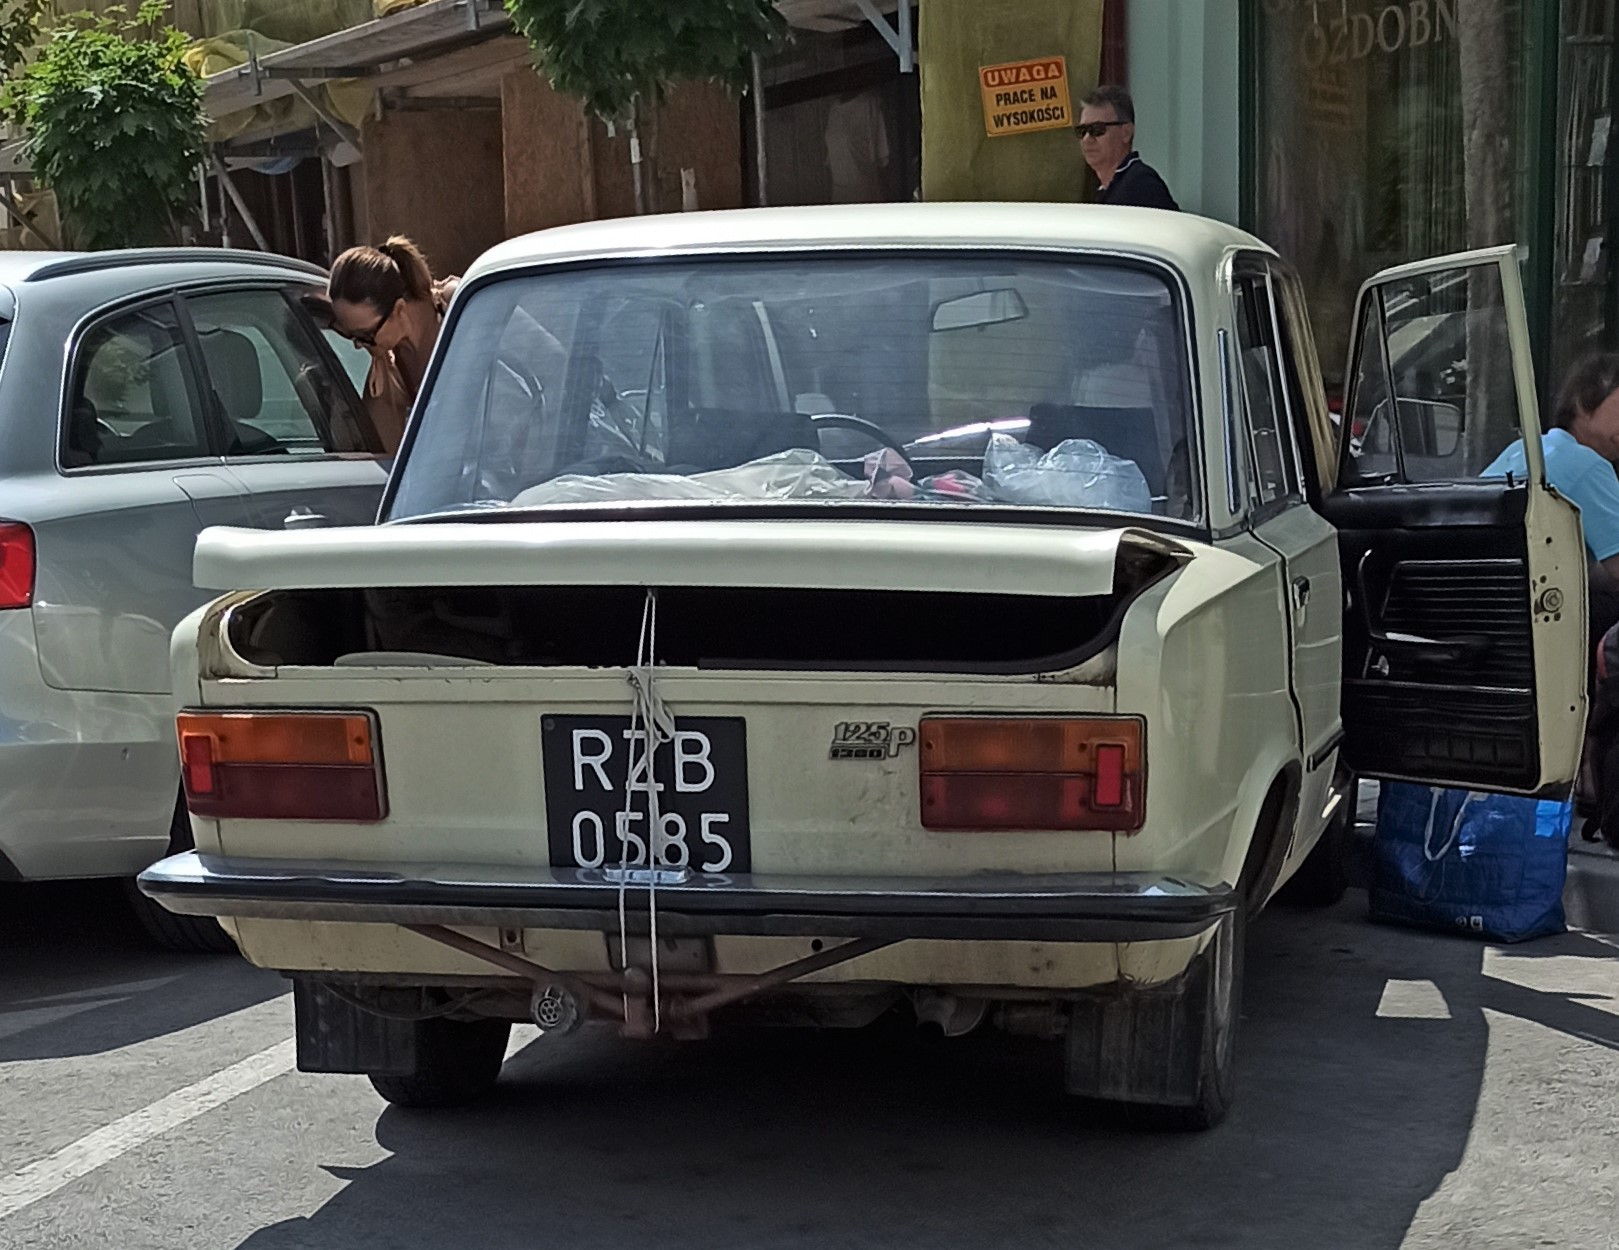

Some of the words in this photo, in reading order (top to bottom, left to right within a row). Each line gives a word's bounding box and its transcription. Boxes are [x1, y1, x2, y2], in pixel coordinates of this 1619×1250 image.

[987, 64, 1060, 86] UWAGA
[995, 89, 1036, 107] PRACE
[1040, 86, 1058, 101] NA
[993, 103, 1065, 128] WYSOKOŚCI
[572, 729, 715, 792] RZB
[572, 810, 733, 873] 0585
